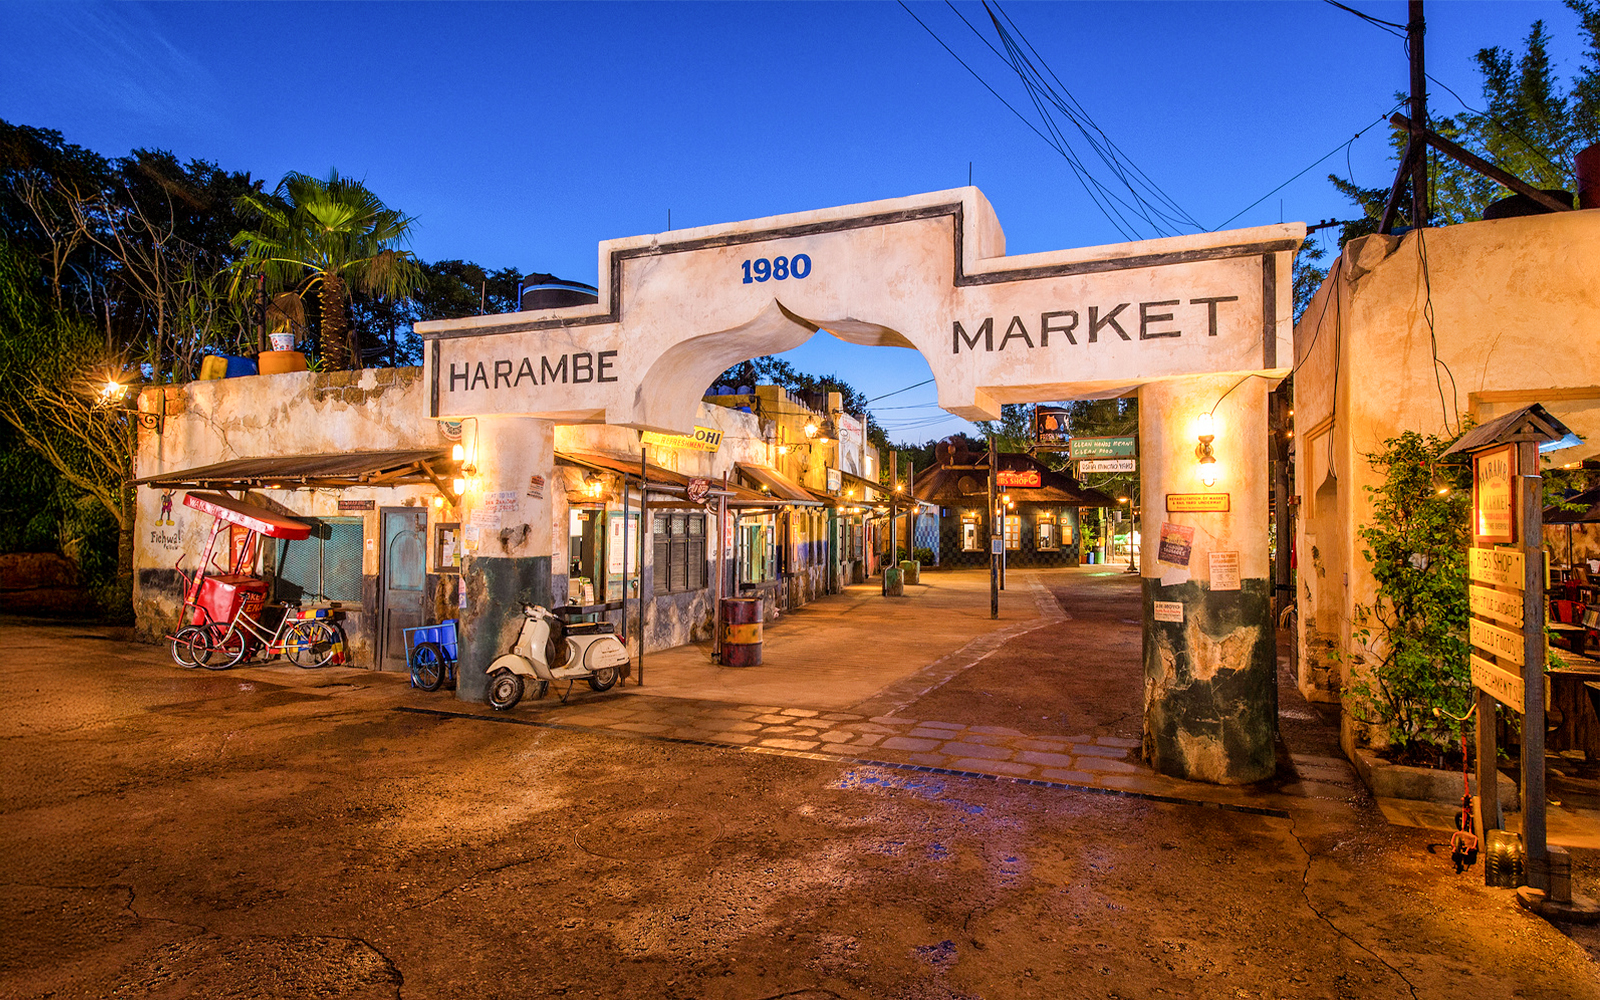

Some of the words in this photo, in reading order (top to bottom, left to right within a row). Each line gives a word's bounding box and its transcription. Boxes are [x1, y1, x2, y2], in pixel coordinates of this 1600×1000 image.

[741, 253, 812, 284] 1980
[952, 295, 1239, 354] MARKET
[449, 350, 618, 392] HARAMBE
[1009, 477, 1028, 485] SHOP
[1479, 459, 1509, 491] HARAMB
[1483, 494, 1508, 510] MARKET
[1493, 553, 1513, 572] SHOP
[1495, 633, 1516, 657] FOODS
